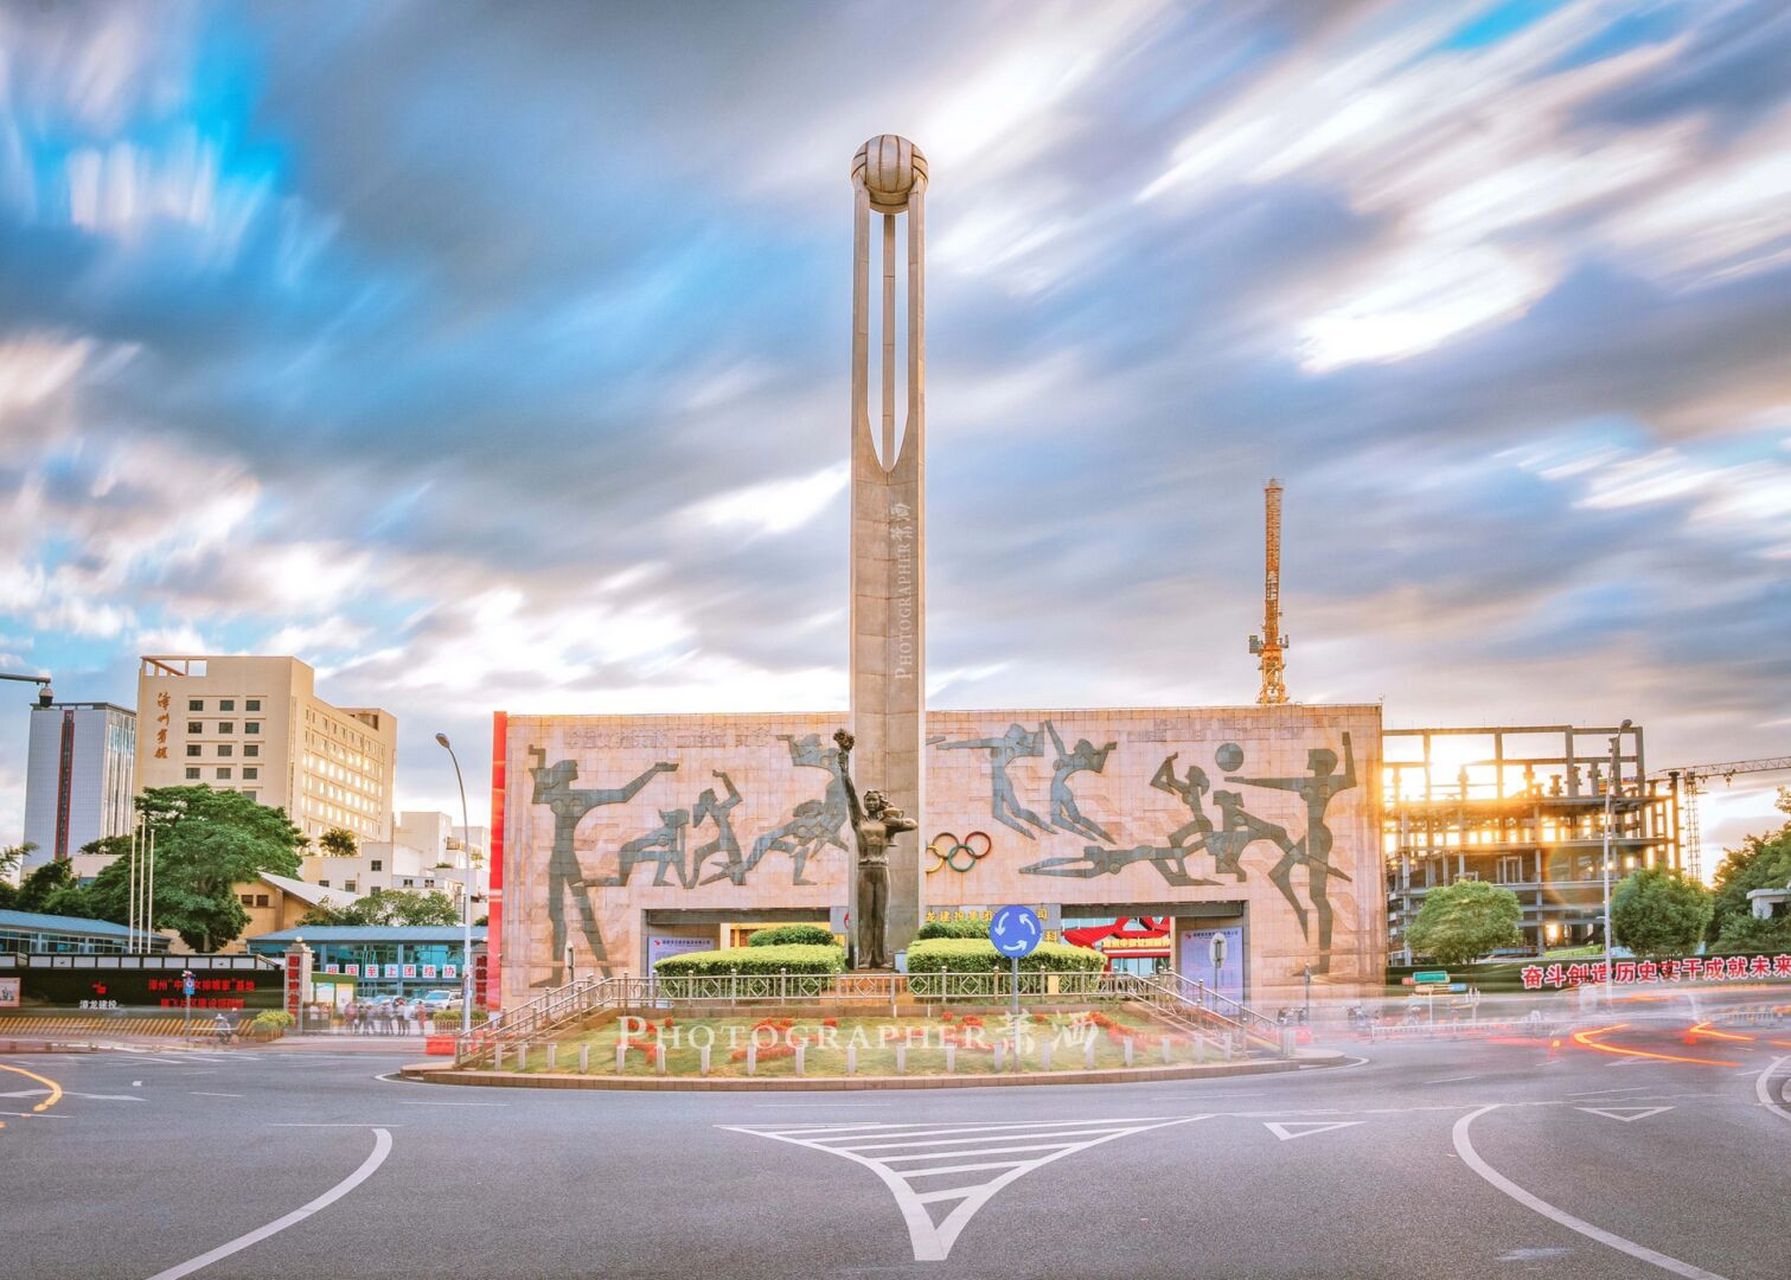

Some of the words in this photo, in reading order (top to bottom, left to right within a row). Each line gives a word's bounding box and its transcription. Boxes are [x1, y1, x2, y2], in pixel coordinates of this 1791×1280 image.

[1521, 954, 1791, 989] 奋斗创造历史实干成就未来
